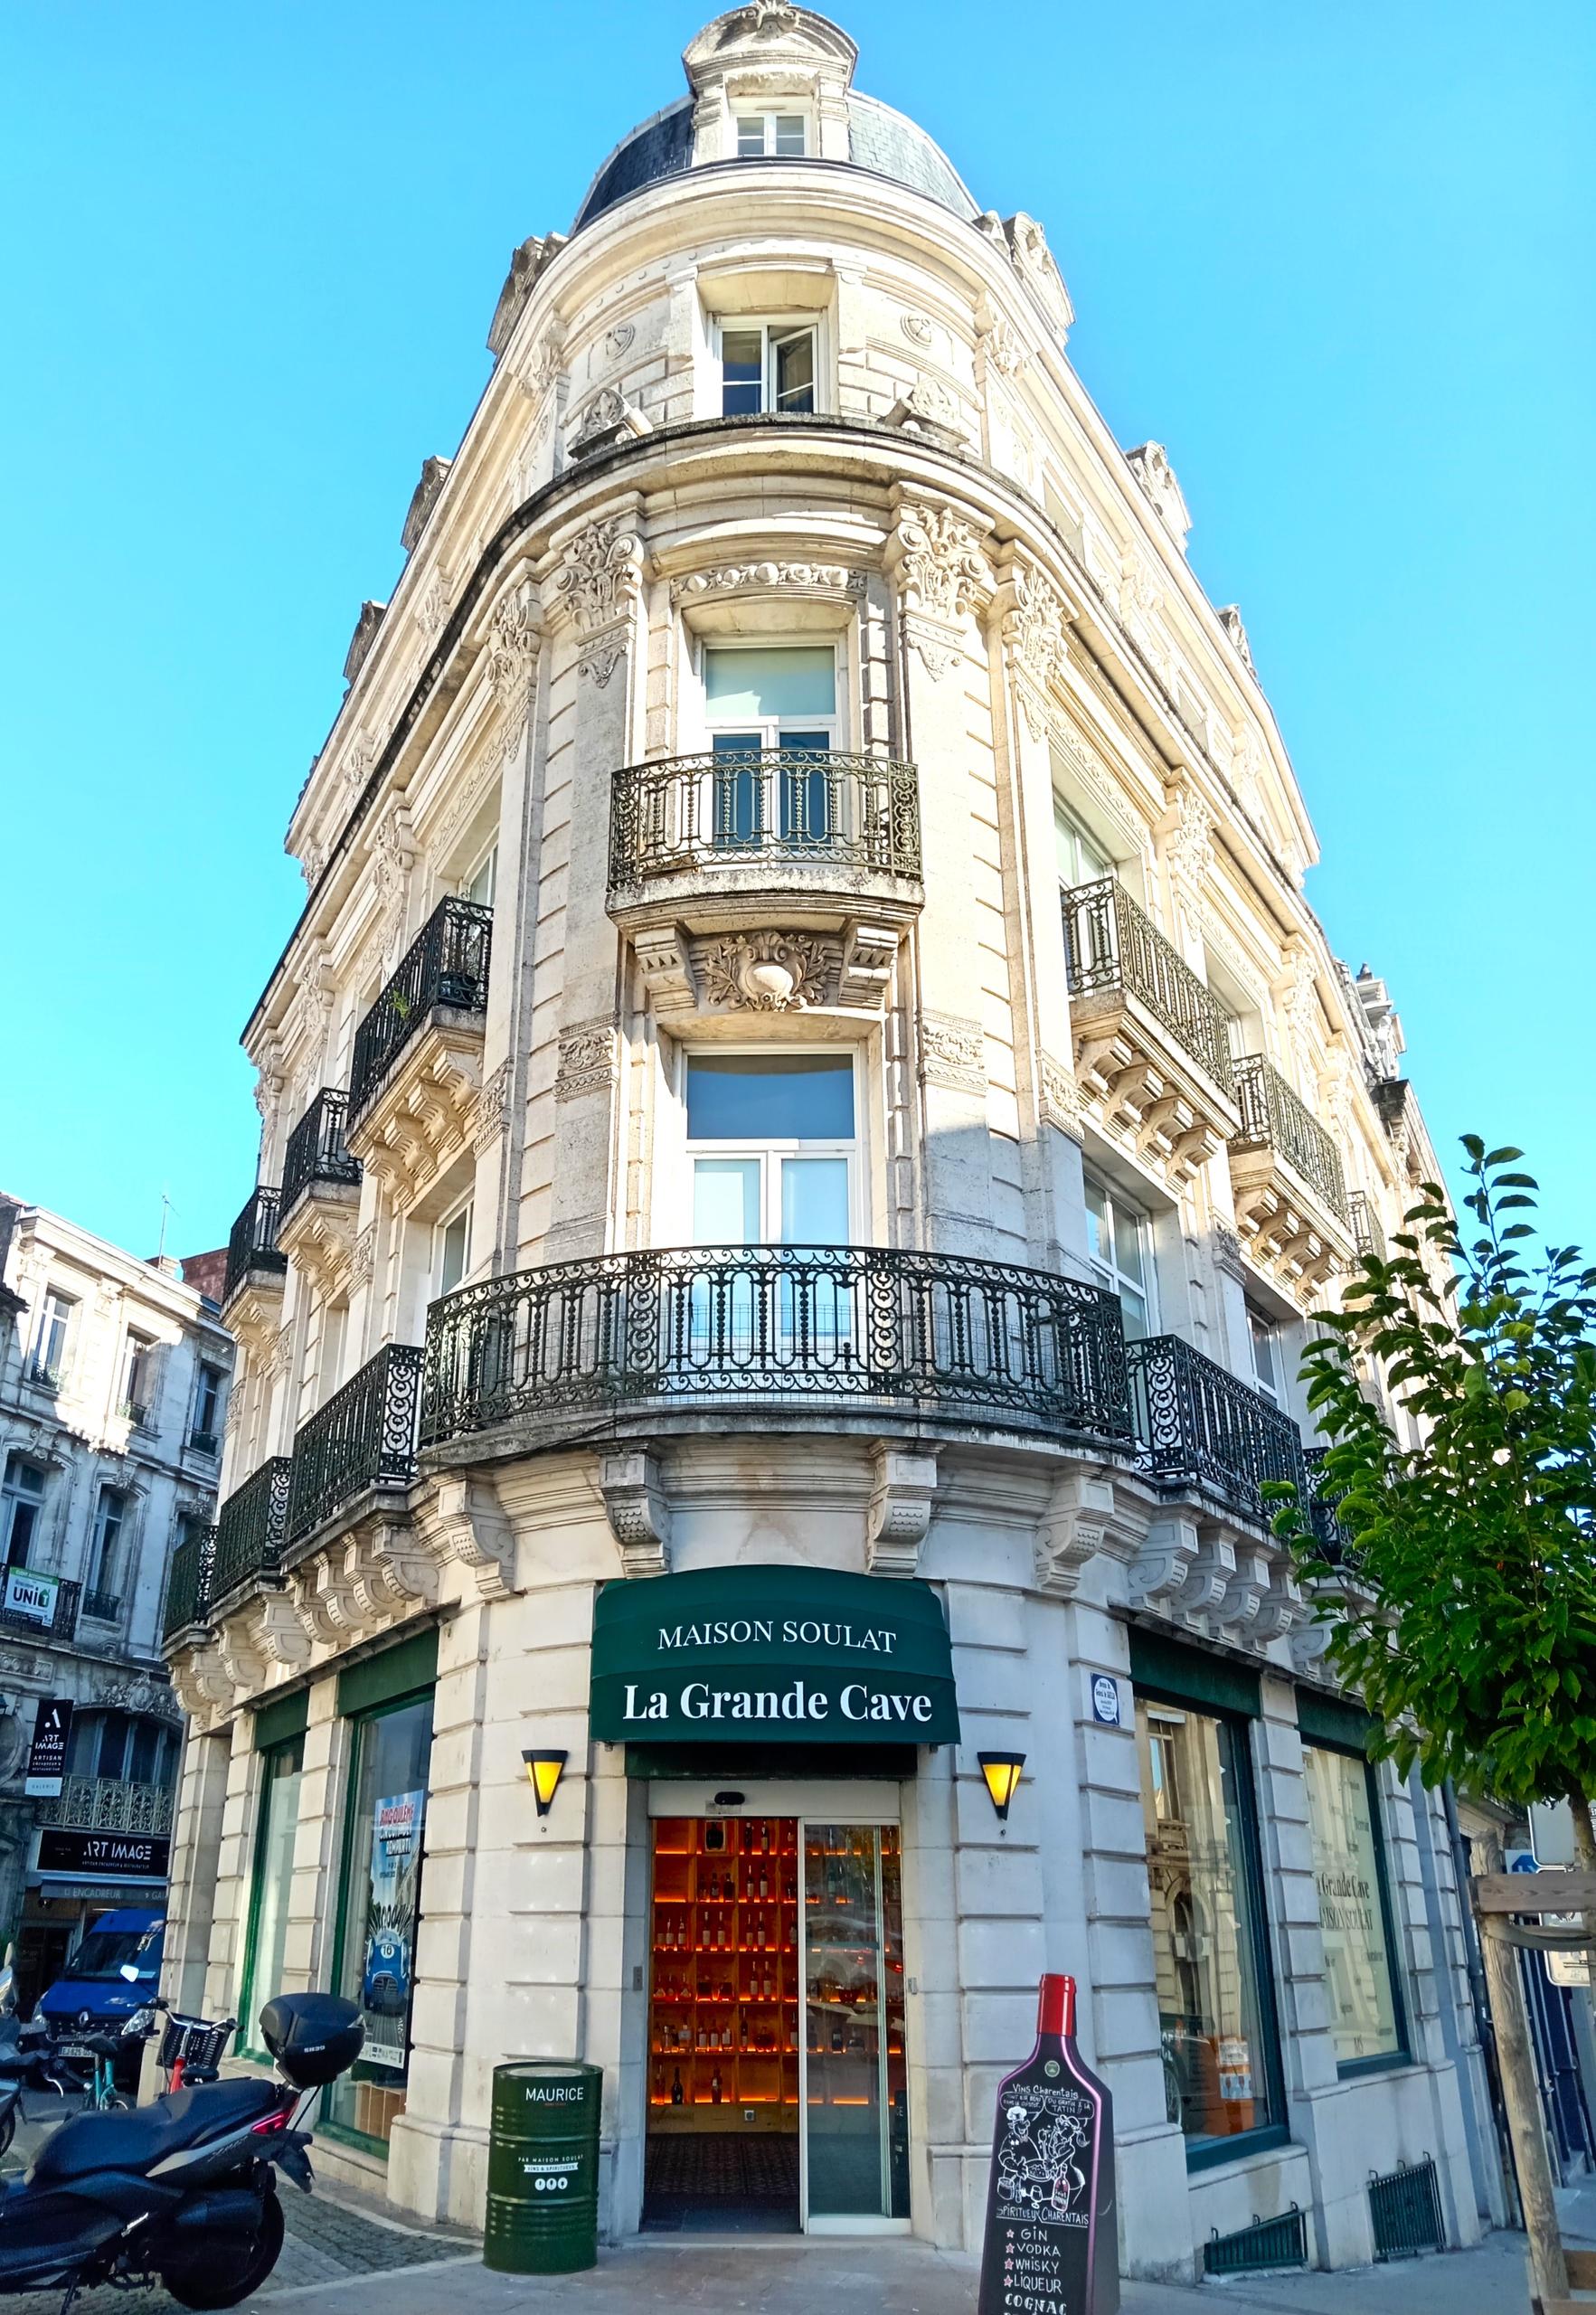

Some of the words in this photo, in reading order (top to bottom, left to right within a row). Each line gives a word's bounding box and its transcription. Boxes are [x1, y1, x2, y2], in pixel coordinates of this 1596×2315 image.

[657, 1620, 773, 1650] MAISON
[782, 1620, 897, 1654] SOULAT
[622, 1685, 669, 1720] La
[680, 1681, 828, 1720] Grande
[839, 1684, 933, 1723] Cave
[34, 1742, 64, 1750] IMAGE
[42, 1734, 60, 1743] ART
[83, 1840, 109, 1857] ART
[111, 1843, 152, 1860] IMAGE
[72, 1887, 121, 1899] ENCADREUR
[1322, 1872, 1351, 1897] Grande
[1352, 1875, 1370, 1899] Cave
[525, 2087, 584, 2102] MAURICE
[1052, 2104, 1075, 2113] TATIN
[562, 2154, 583, 2162] SOULAT
[1016, 2243, 1061, 2258] VODKA
[1005, 2293, 1067, 2315] COGNAC
